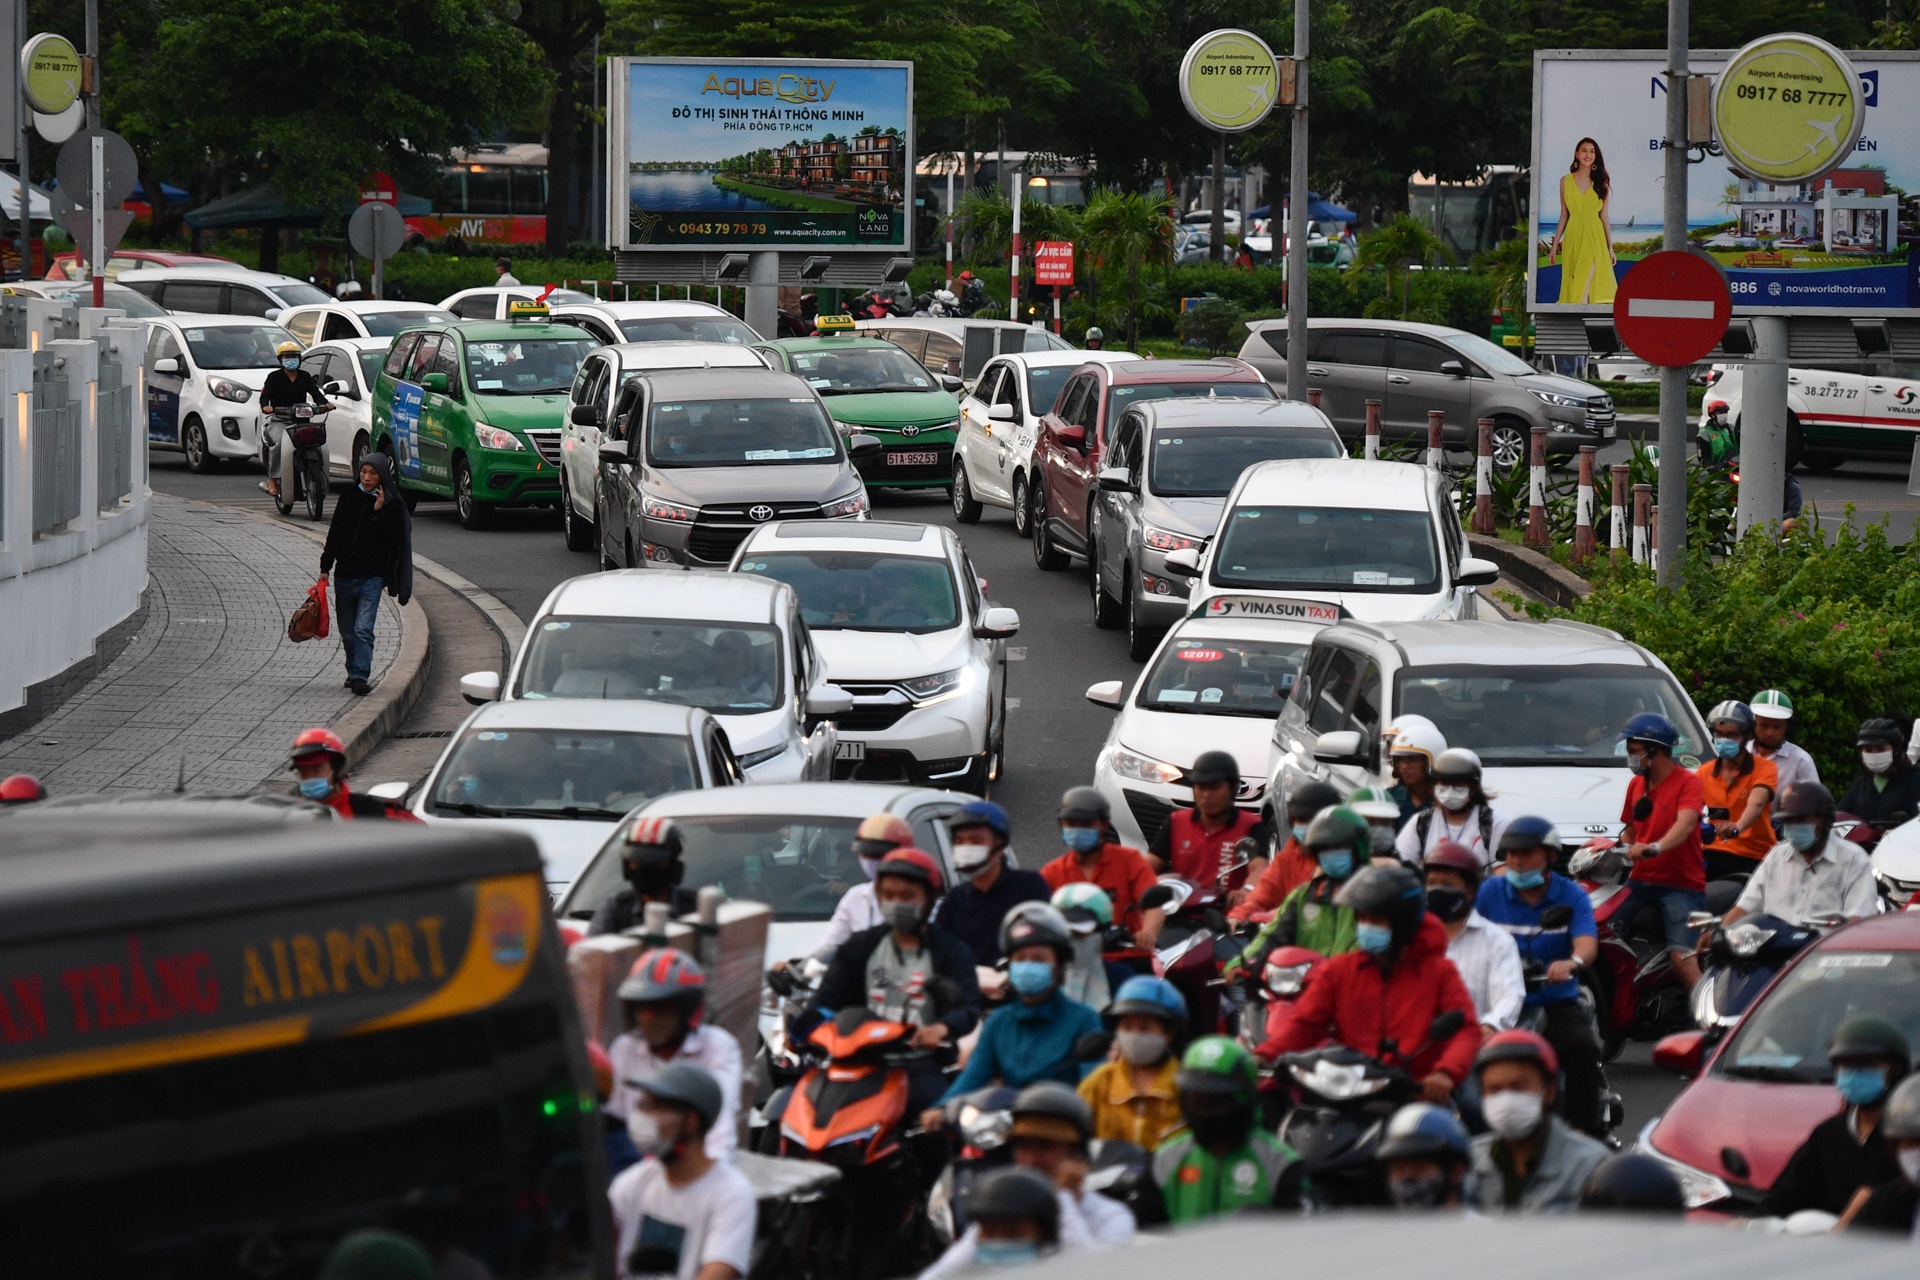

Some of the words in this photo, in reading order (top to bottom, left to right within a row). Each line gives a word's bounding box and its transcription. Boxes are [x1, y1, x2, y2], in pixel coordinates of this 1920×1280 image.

[35, 62, 51, 71] 0917
[52, 63, 61, 72] 68
[62, 64, 78, 73] 7777
[1201, 65, 1227, 75] 0917
[1229, 65, 1243, 75] 68
[1245, 65, 1271, 75] 7777
[1747, 69, 1776, 79] Airport
[1777, 71, 1824, 83] Advertising
[1737, 84, 1777, 101] 0917
[1782, 89, 1802, 103] 68
[1807, 91, 1848, 107] 7777
[672, 105, 691, 119] ĐÔ
[695, 108, 715, 122] THỊ
[719, 108, 749, 119] SINH
[752, 106, 781, 120] THÁI
[785, 107, 828, 121] THÔNG
[832, 110, 864, 121] MINH
[724, 121, 746, 131] PHÍA
[750, 122, 777, 131] ĐÔNG
[779, 123, 813, 132] TP.HCM
[679, 222, 711, 234] 0943
[715, 223, 730, 235] 79
[733, 223, 748, 235] 79
[751, 224, 767, 235] 79
[774, 228, 847, 237] www.aquacity.com.vn
[859, 224, 889, 232] LAND
[1786, 284, 1887, 294] novaworldhotram.vn
[823, 316, 851, 324] TAXI
[1804, 386, 1831, 397] 38.27
[1833, 388, 1844, 398] 27
[1847, 389, 1859, 399] 27
[888, 454, 937, 465] 51A-952.53
[1239, 601, 1306, 617] VINASUN
[1307, 606, 1337, 620] TAXI
[1184, 651, 1217, 659] 12011
[242, 916, 447, 1009] AIRPORT
